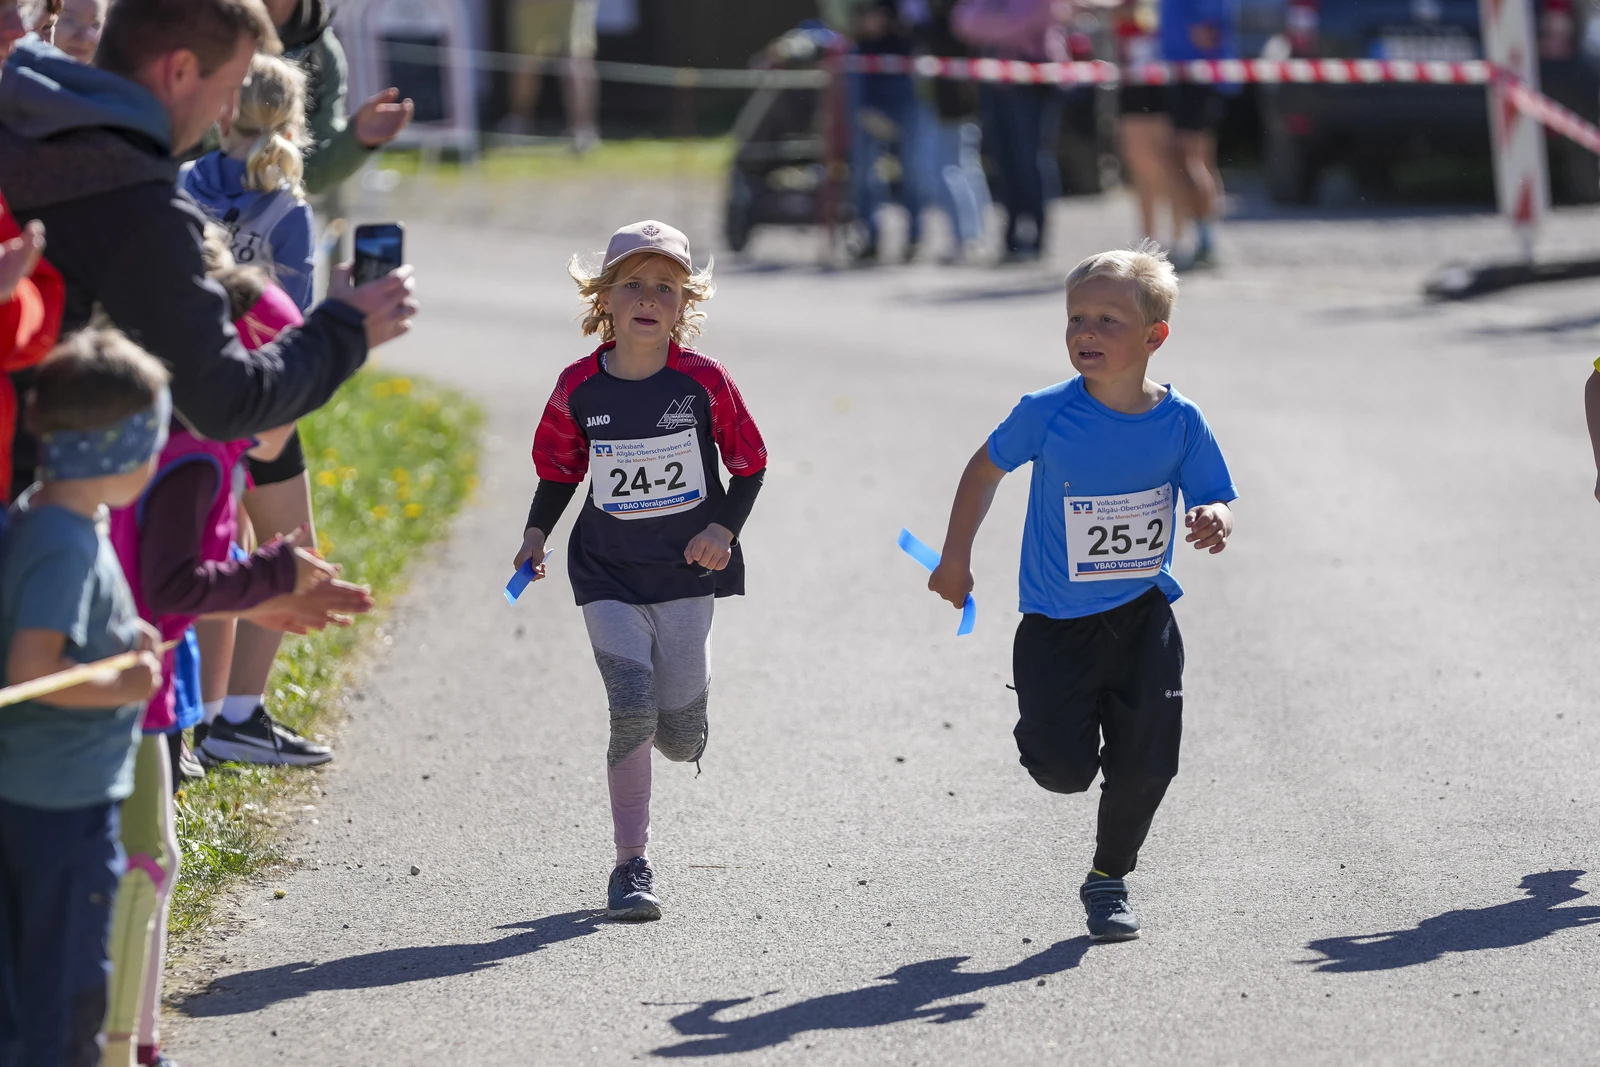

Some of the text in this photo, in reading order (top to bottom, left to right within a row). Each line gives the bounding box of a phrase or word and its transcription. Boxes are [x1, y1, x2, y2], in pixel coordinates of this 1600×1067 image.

[587, 415, 610, 427] JAKO
[614, 442, 645, 450] Volksbank
[616, 443, 682, 457] Allgäu-Oberschwaben
[610, 462, 686, 497] 24-2
[640, 496, 685, 507] Voralpencup
[1096, 498, 1129, 506] Volksbank
[1097, 499, 1164, 514] Allgäu-Oberschwaben
[1088, 518, 1163, 556] 25-2
[1094, 562, 1116, 570] VBAO
